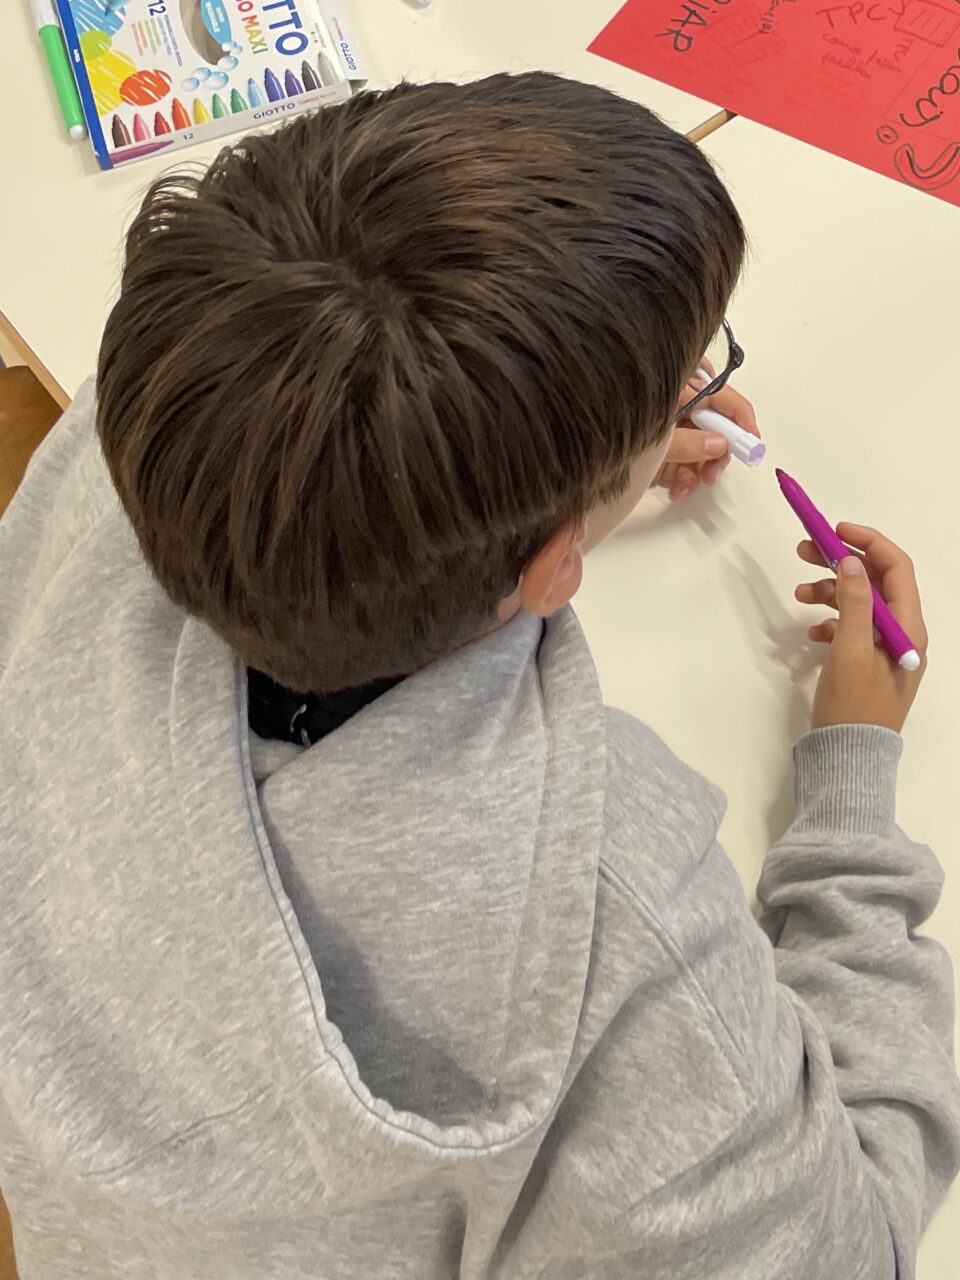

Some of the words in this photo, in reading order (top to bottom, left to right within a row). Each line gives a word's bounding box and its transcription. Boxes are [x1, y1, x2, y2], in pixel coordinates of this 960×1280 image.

[814, 1, 888, 29] TPC
[241, 14, 269, 55] MAXI
[339, 41, 357, 71] GIOTTO
[253, 102, 296, 120] GIOTTO
